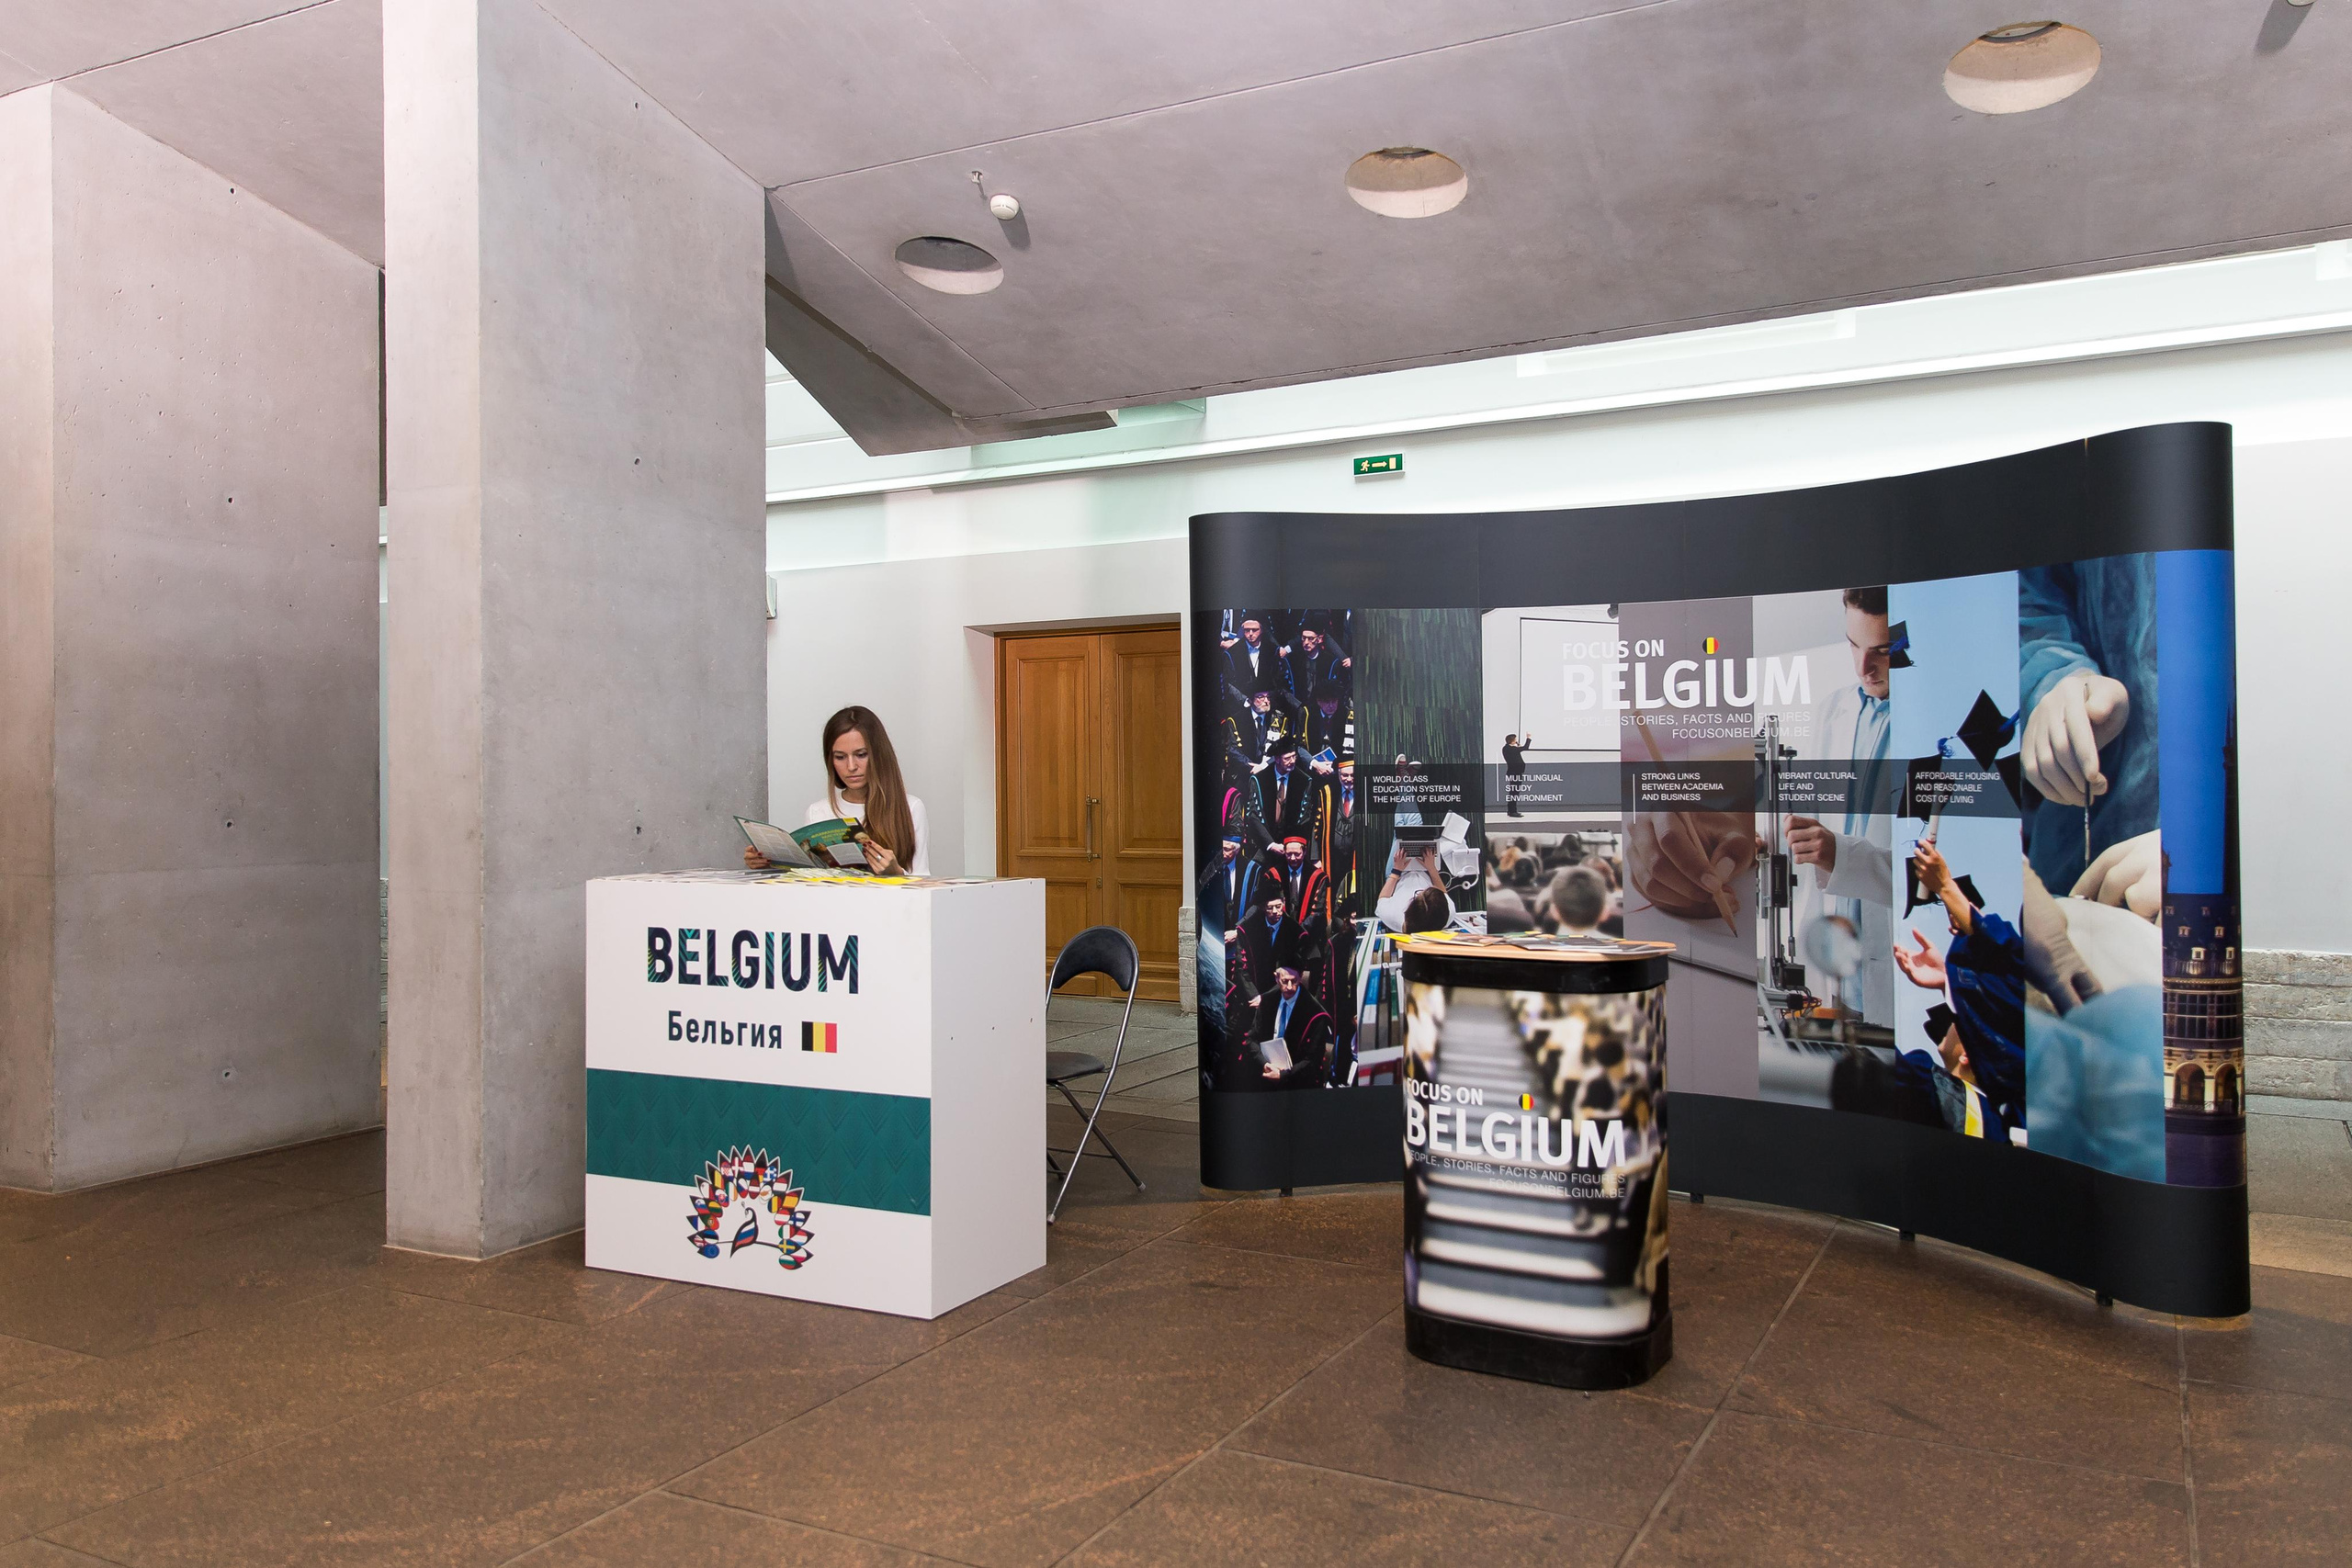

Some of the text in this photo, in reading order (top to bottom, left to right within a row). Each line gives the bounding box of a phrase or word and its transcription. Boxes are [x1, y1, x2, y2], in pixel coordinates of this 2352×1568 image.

[1563, 639, 1664, 660] FOCUS ON
[1563, 655, 1811, 711] BELGIUM
[1683, 713, 1722, 725] FACTS
[1726, 712, 1753, 724] AND
[1757, 711, 1811, 723] FIGURES
[1672, 726, 1810, 739] FOCUSONBELGIUM.BE
[1641, 773, 1701, 781] STRONG LINKS
[1778, 772, 1858, 780] VIBRANT CULTURAL
[1915, 772, 2001, 781] AFFORDABLE HOUSING
[1373, 785, 1418, 794] EDUCATION
[1419, 784, 1450, 793] SYSTEM
[1641, 783, 1724, 791] BETWEEN ACADEMIA
[1778, 783, 1814, 791] LIFE AND
[1915, 783, 1982, 792] AND REASONABLE
[1373, 795, 1461, 804] THE HEART OF EUROPE
[1505, 794, 1564, 802] ENVIRONMENT
[1661, 793, 1701, 801] BUSINESS
[1778, 793, 1845, 802] STUDENT SCENE
[1916, 795, 1974, 804] COST OF LIVING
[648, 927, 859, 995] BELGIUM
[668, 1010, 782, 1049] Бельгия
[1407, 1077, 1483, 1106] FOCUS ON
[1407, 1098, 1626, 1168] BELGIUM
[1408, 1149, 1440, 1167] EOPLE,
[1499, 1166, 1537, 1179] FACTS
[1541, 1170, 1566, 1183] AND
[1571, 1173, 1625, 1185] FIGURES
